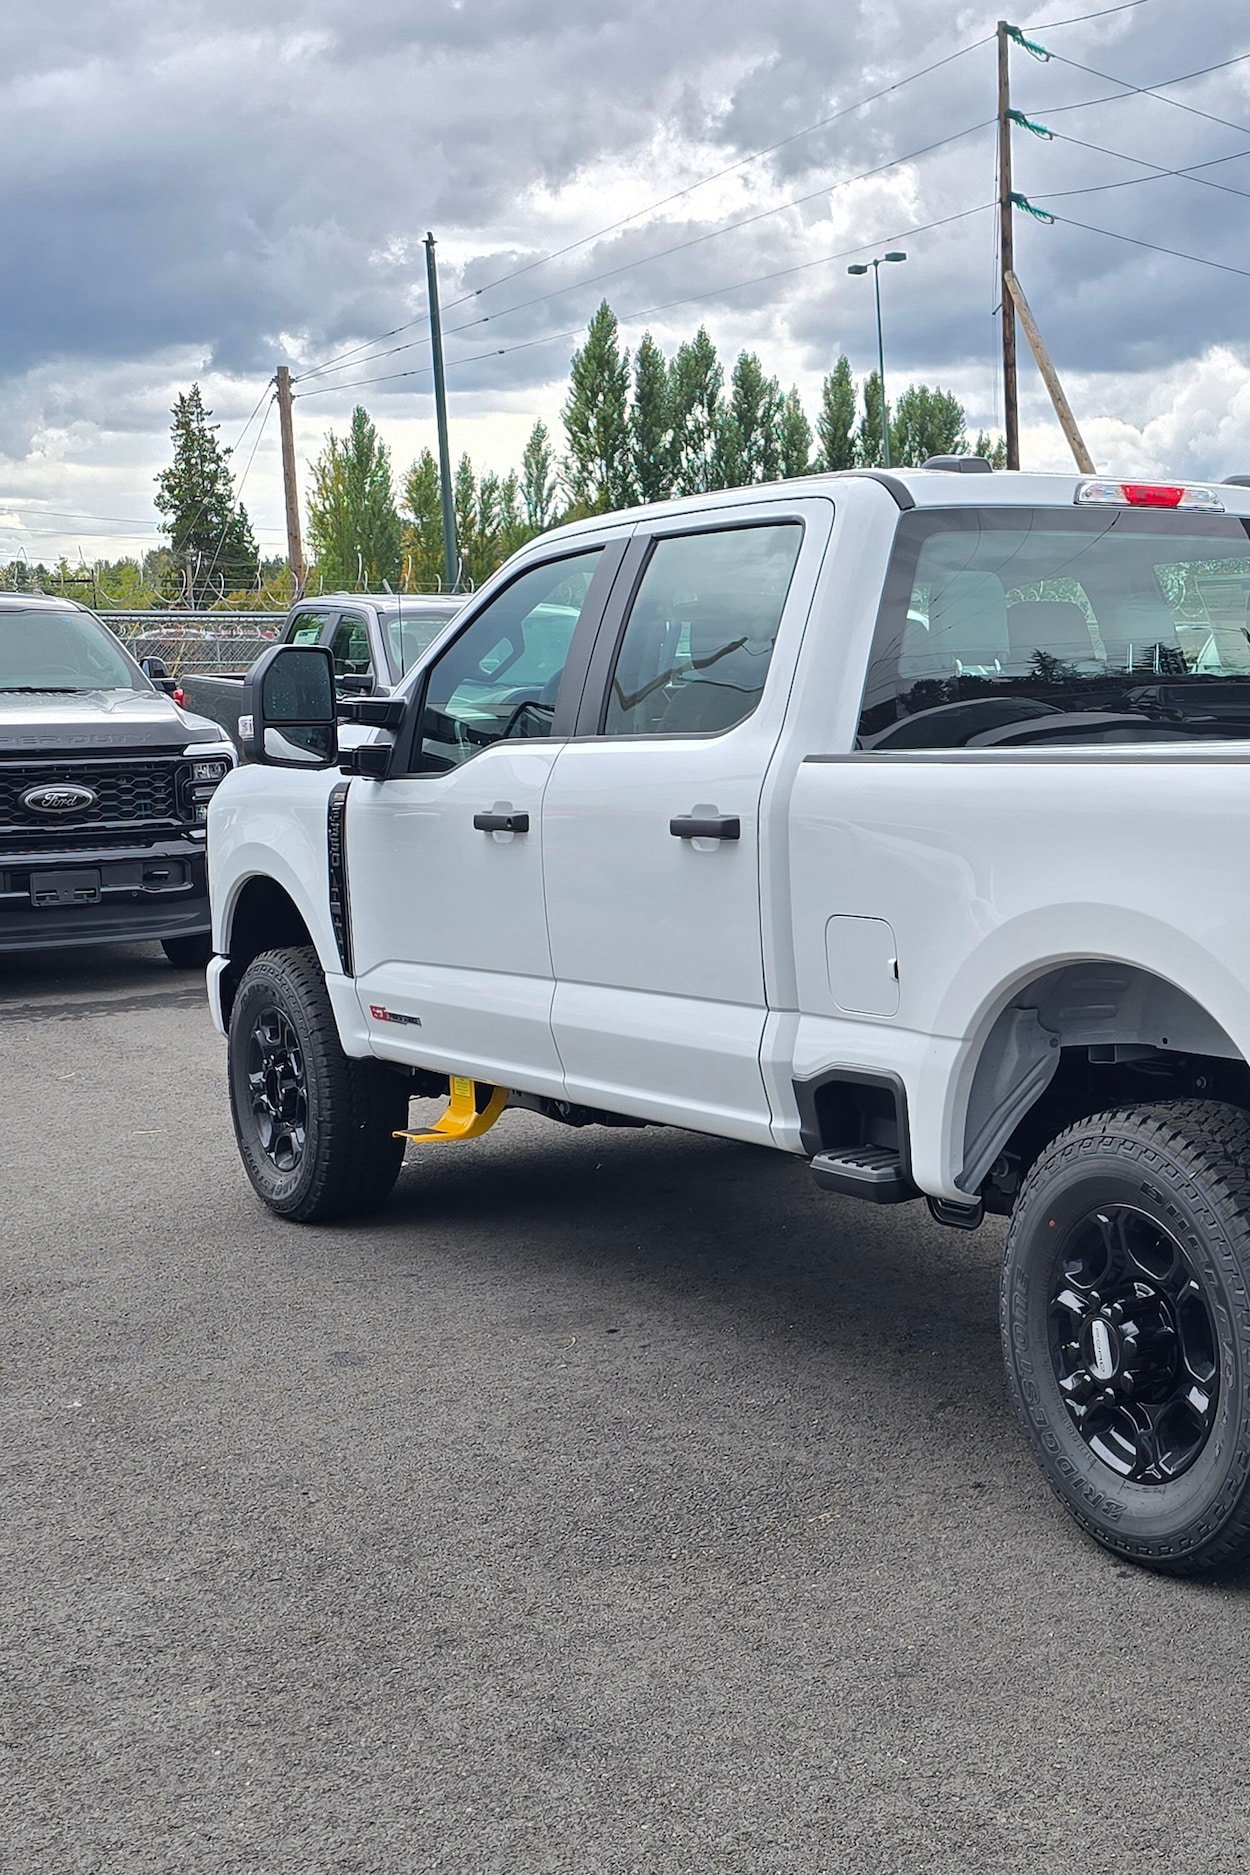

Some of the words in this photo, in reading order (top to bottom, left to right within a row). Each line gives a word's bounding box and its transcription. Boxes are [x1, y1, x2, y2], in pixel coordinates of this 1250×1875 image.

[0, 734, 61, 746] PER
[68, 733, 151, 745] DUTY
[1012, 1265, 1128, 1522] BRIDGESTONE
